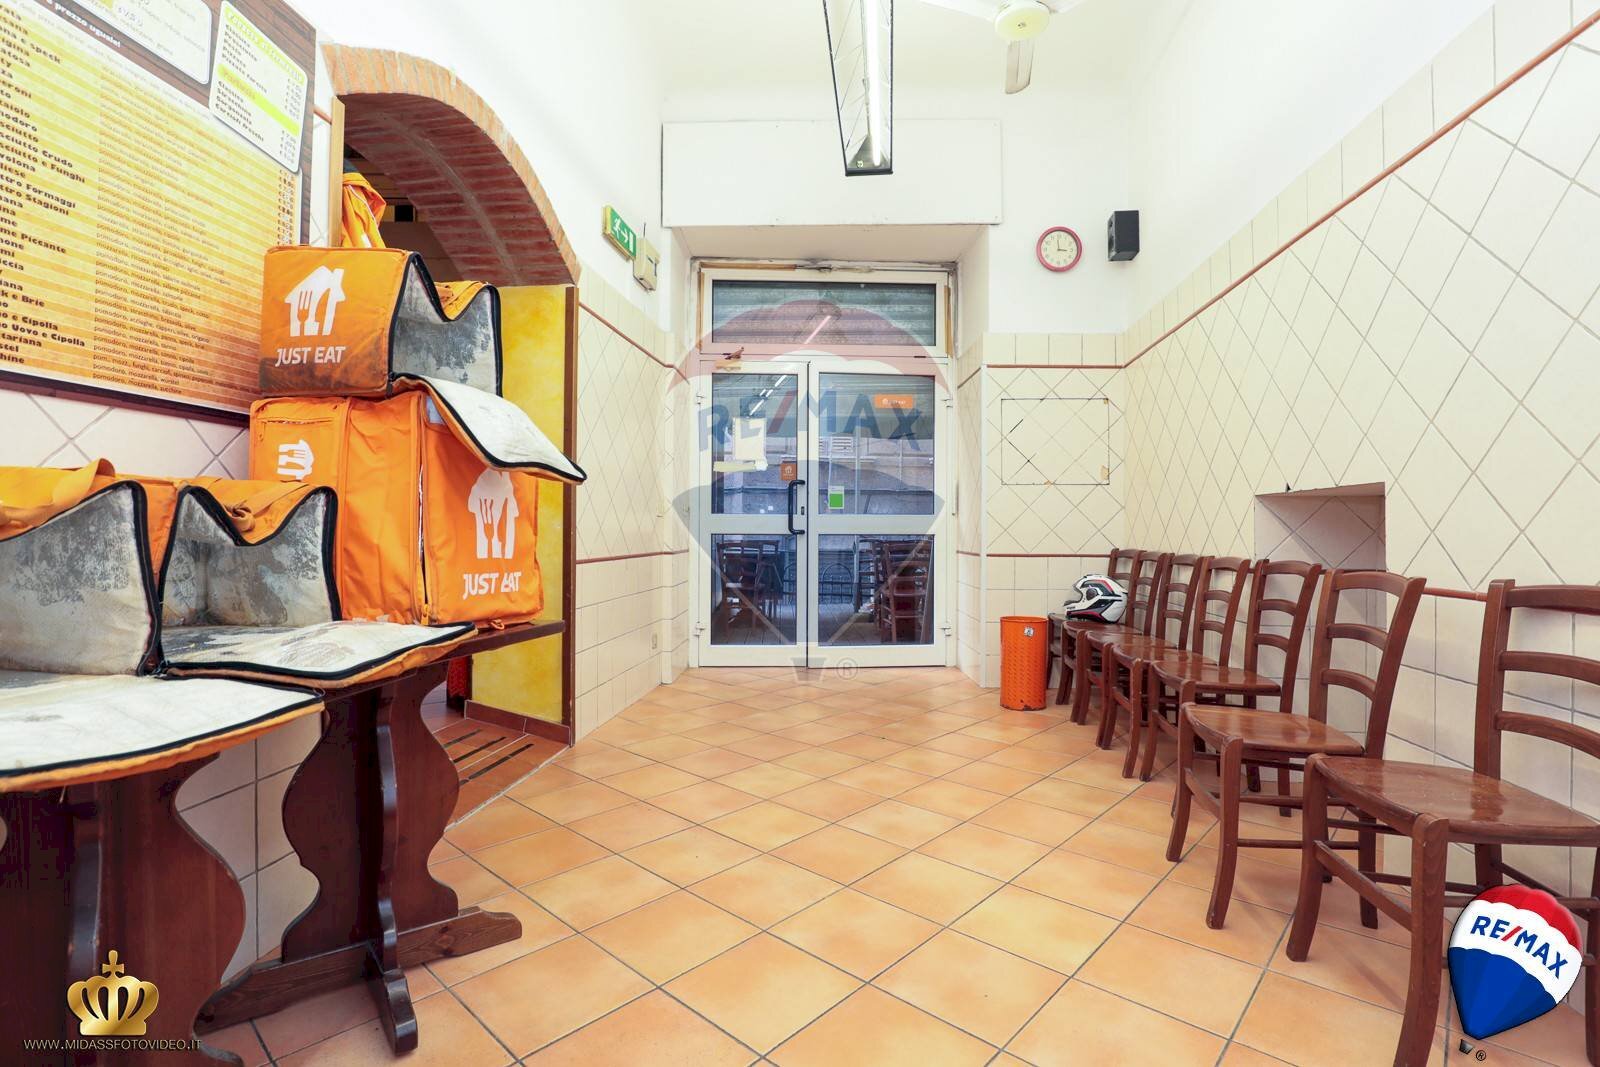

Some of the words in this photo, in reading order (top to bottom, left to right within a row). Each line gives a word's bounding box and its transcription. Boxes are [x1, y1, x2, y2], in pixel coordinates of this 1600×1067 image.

[50, 163, 85, 183] Funghi
[26, 183, 76, 208] Formaggi
[26, 194, 69, 216] Stagioni
[21, 233, 66, 254] Piccante
[21, 294, 45, 307] Brie
[22, 316, 58, 331] Cipolla
[12, 324, 39, 336] Uovo
[51, 333, 85, 347] Cipolla
[275, 347, 312, 367] JUST
[314, 346, 346, 364] EAT
[463, 572, 499, 600] JUST
